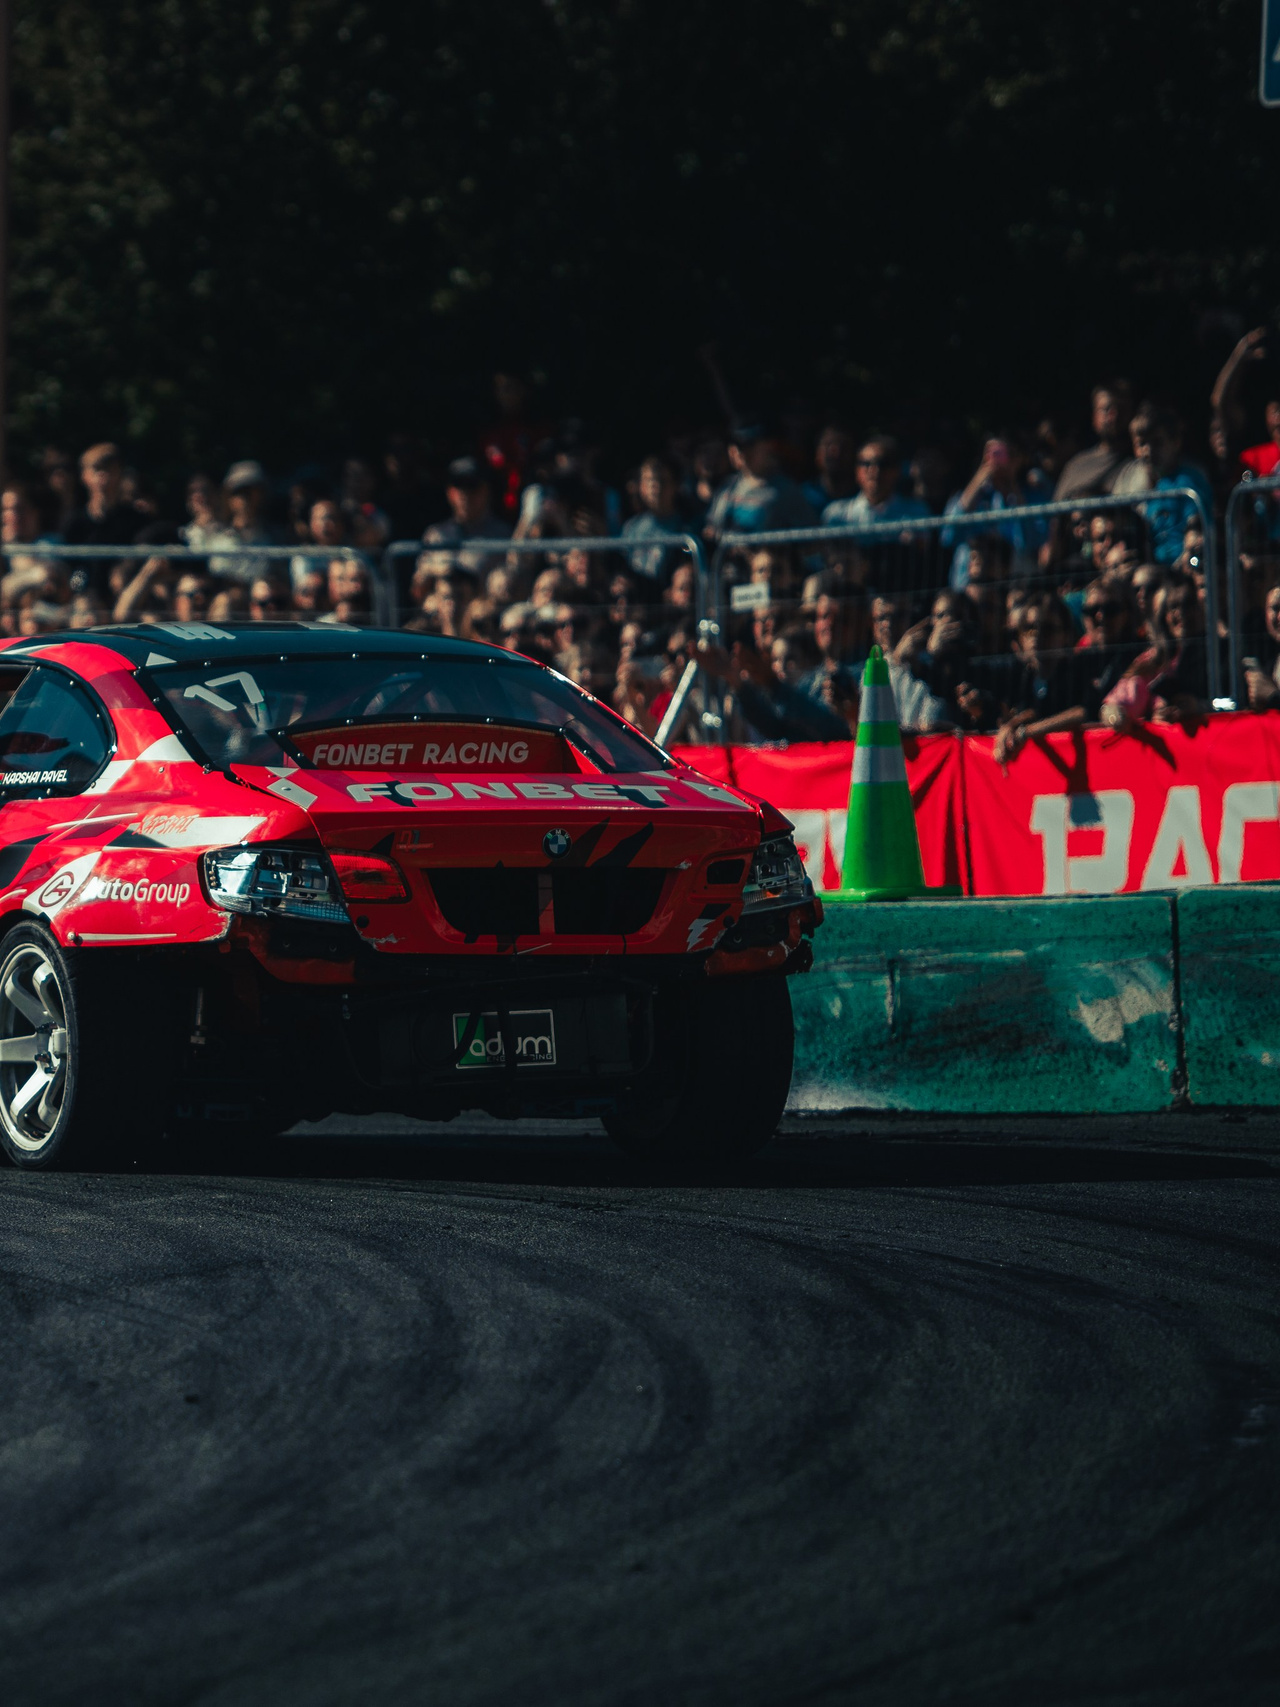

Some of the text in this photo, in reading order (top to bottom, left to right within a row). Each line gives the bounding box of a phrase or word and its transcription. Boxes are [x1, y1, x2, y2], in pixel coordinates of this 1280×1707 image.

[183, 671, 264, 712] 17
[312, 741, 529, 766] FONBET RACING
[347, 782, 671, 802] FONBET
